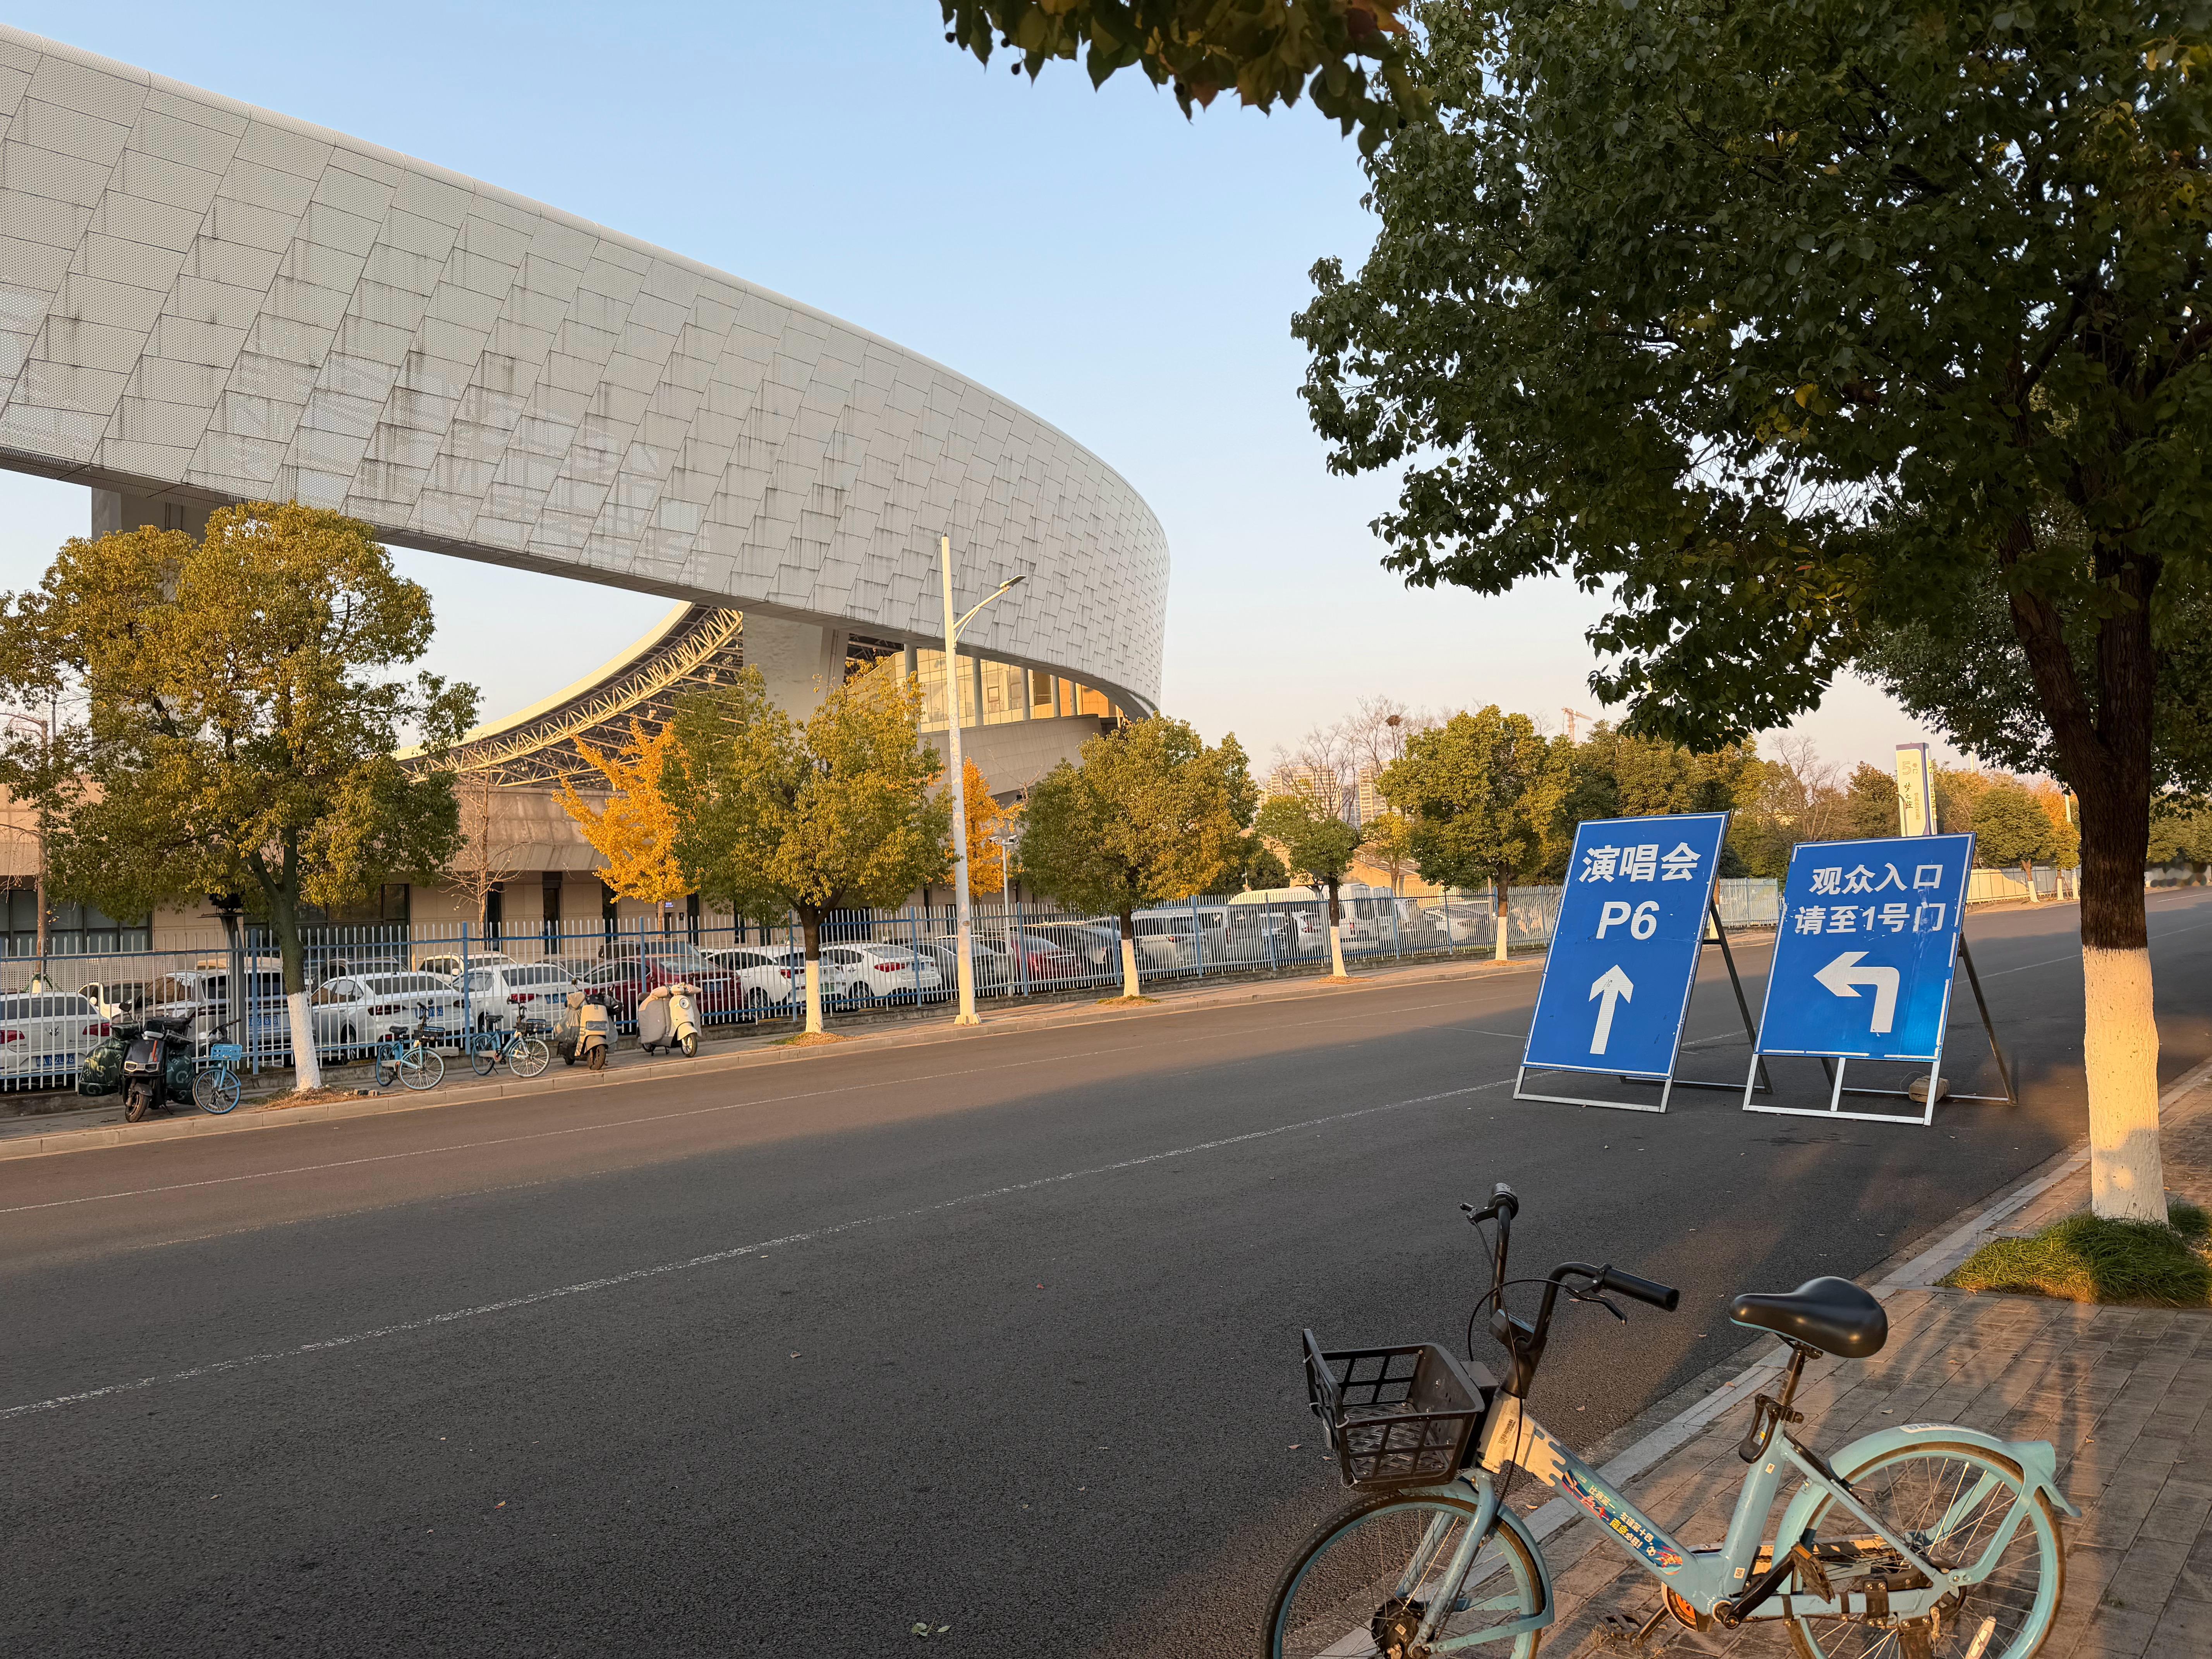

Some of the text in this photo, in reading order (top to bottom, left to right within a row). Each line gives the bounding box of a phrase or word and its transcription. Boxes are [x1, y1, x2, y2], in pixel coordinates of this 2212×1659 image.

[1579, 842, 1701, 883] 演唱会
[1809, 862, 1943, 896] 观众入口
[1596, 900, 1660, 940] P6
[1794, 902, 1946, 935] 请至1号门
